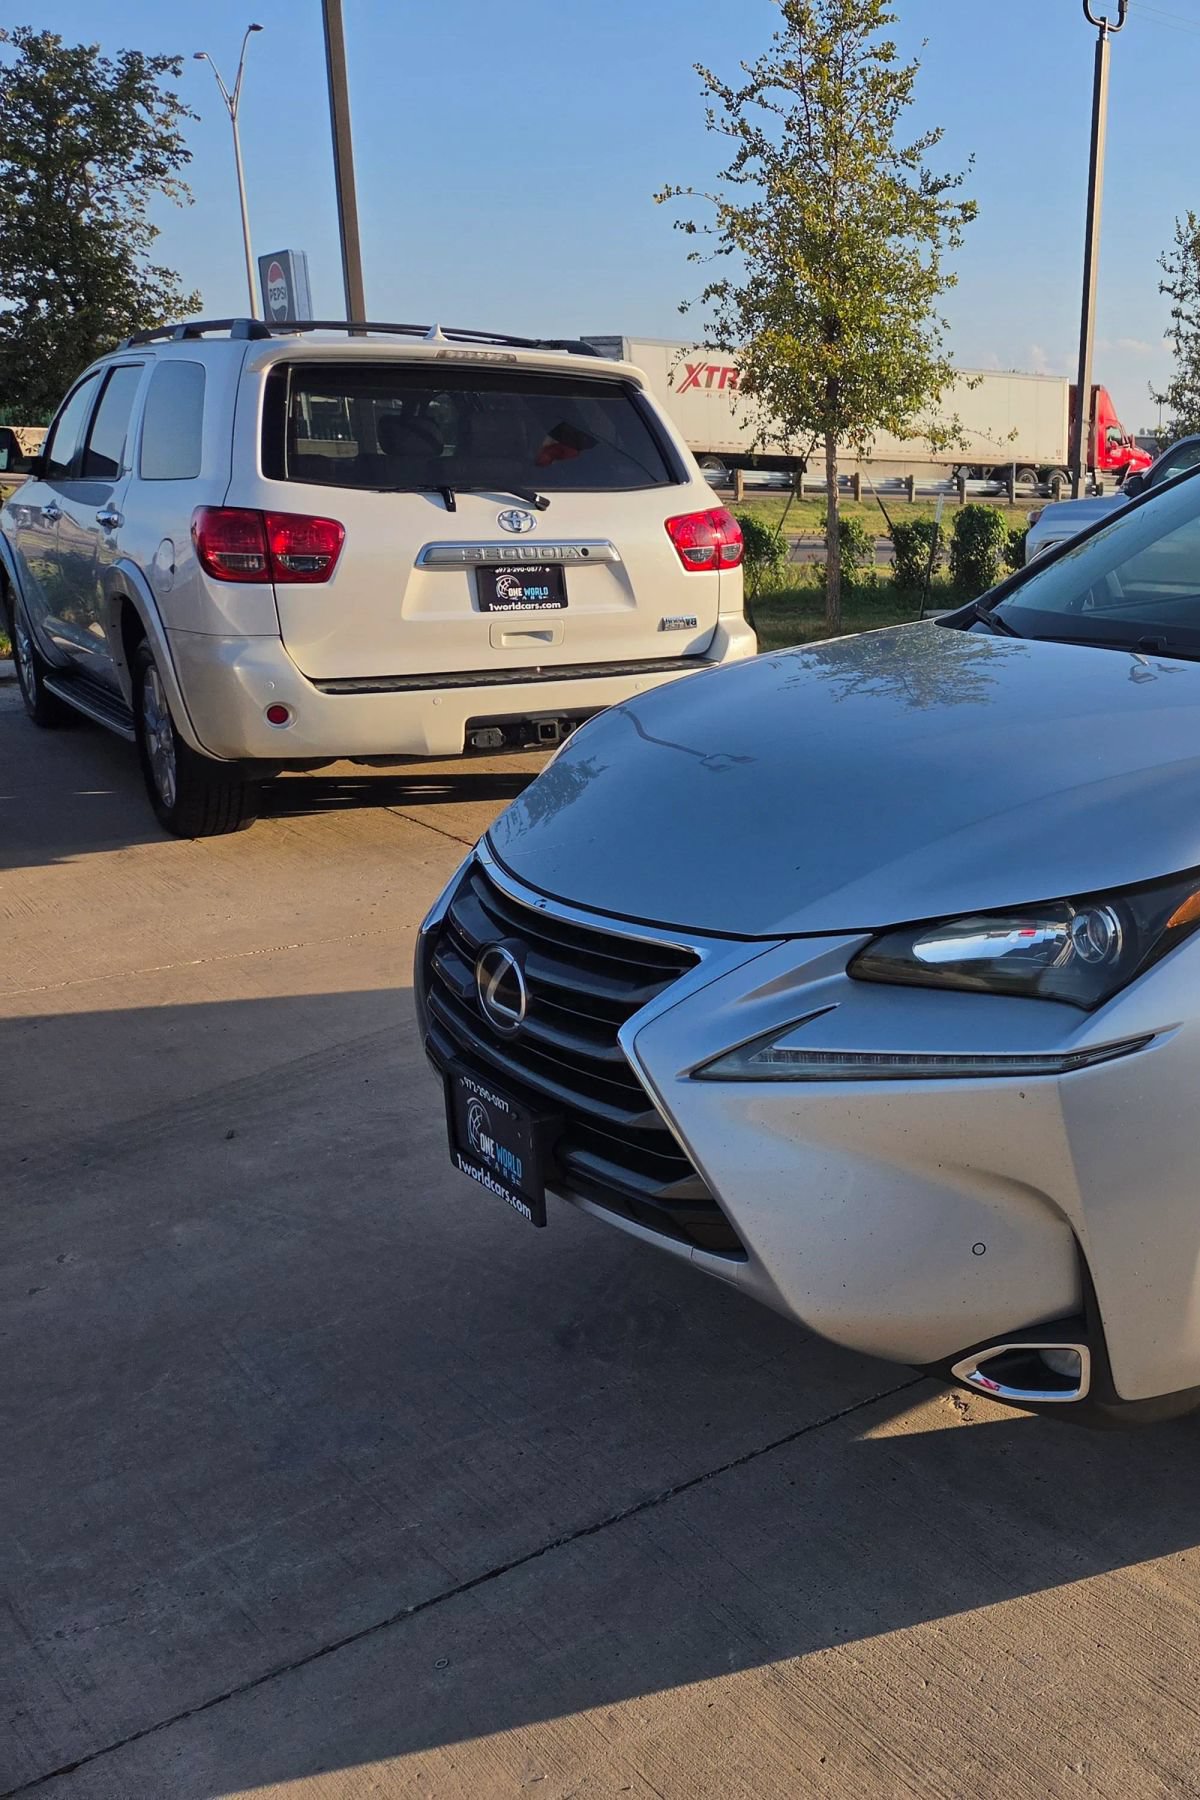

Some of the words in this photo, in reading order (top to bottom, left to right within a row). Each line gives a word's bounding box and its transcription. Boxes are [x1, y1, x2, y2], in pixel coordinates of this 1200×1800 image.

[269, 286, 287, 301] PEPSI
[462, 546, 581, 561] SEQUOIA
[508, 587, 523, 597] ONE
[523, 586, 549, 597] WORLD
[488, 601, 561, 611] 1worldcars.com
[463, 1076, 509, 1113] 972-290-0877
[479, 1132, 495, 1159] ONE
[496, 1143, 522, 1179] WORLD
[456, 1153, 532, 1221] 1worldcars.com
